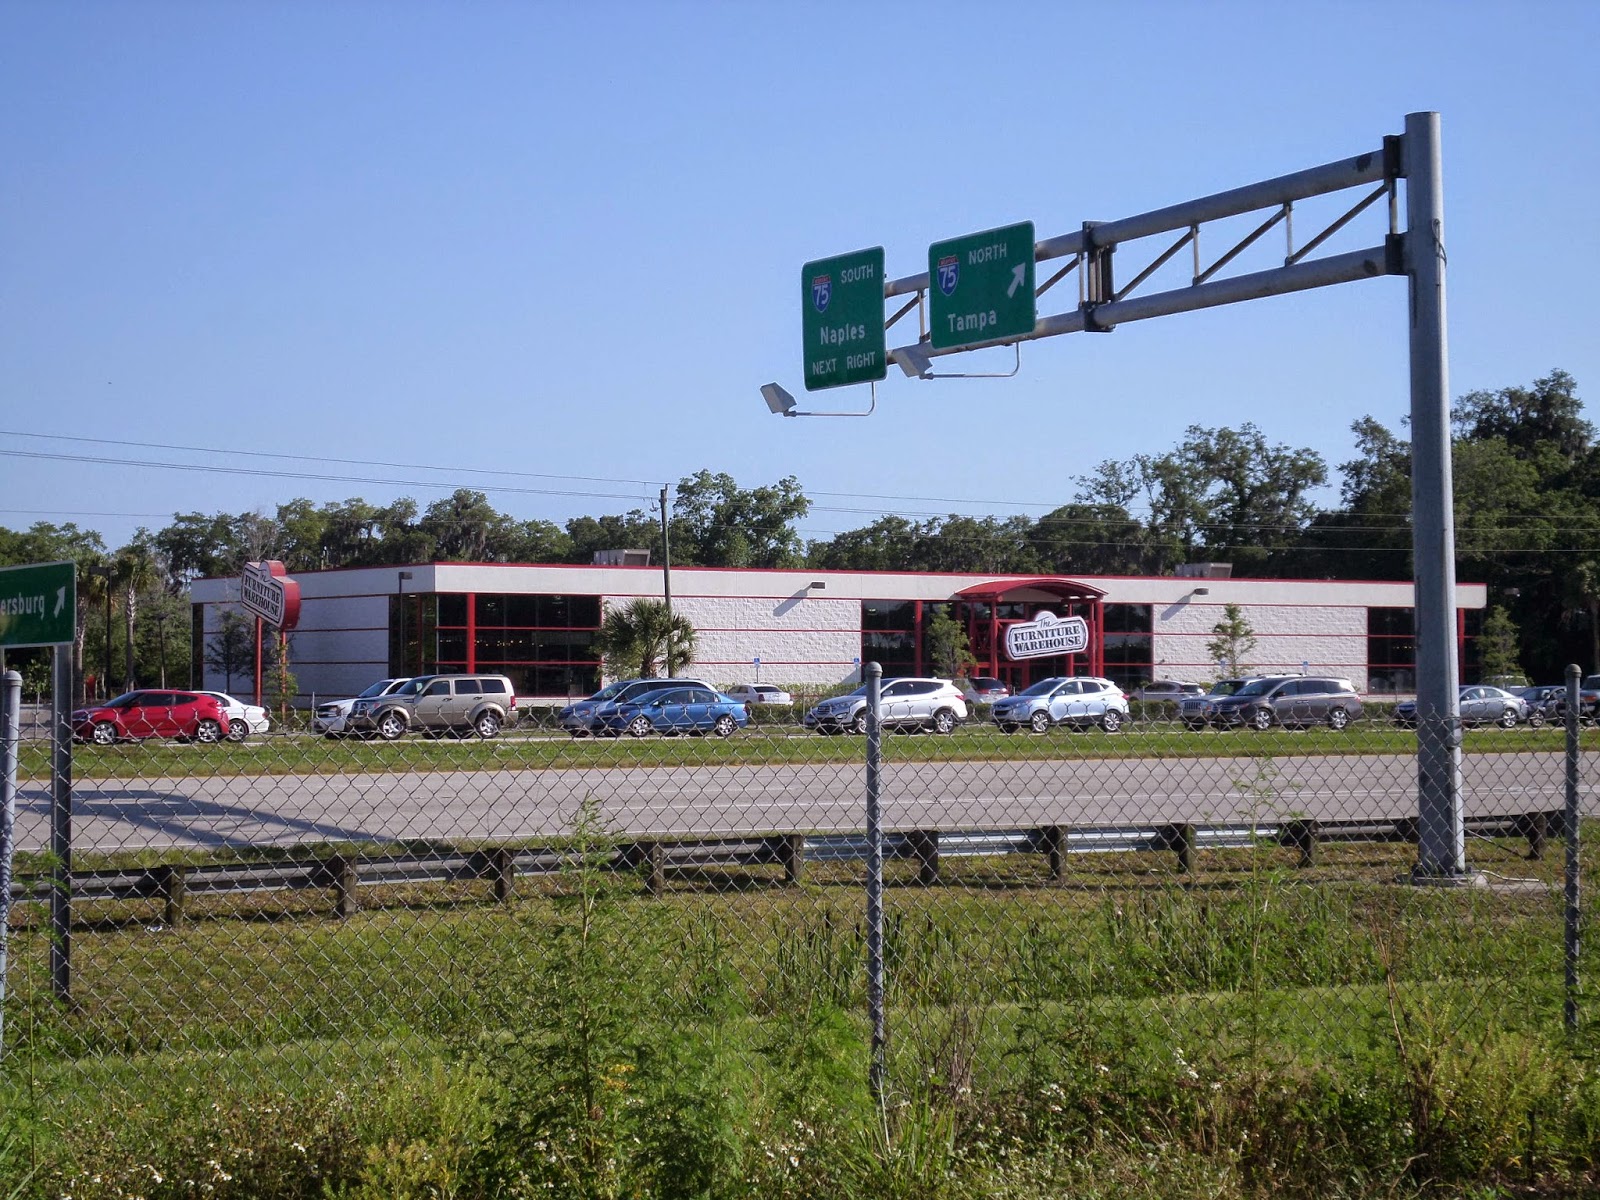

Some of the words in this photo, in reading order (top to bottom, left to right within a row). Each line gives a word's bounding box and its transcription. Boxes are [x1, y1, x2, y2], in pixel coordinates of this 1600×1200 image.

[968, 243, 1007, 265] NORTH
[841, 264, 874, 284] SOUTH
[940, 265, 956, 289] 75
[814, 283, 829, 306] 75
[947, 309, 997, 333] Tampa
[820, 324, 866, 346] Naples
[812, 358, 837, 375] NEXT
[846, 352, 876, 370] RIGHT
[1014, 625, 1080, 642] FURNITURE
[1014, 635, 1081, 652] WAREHOUSE
